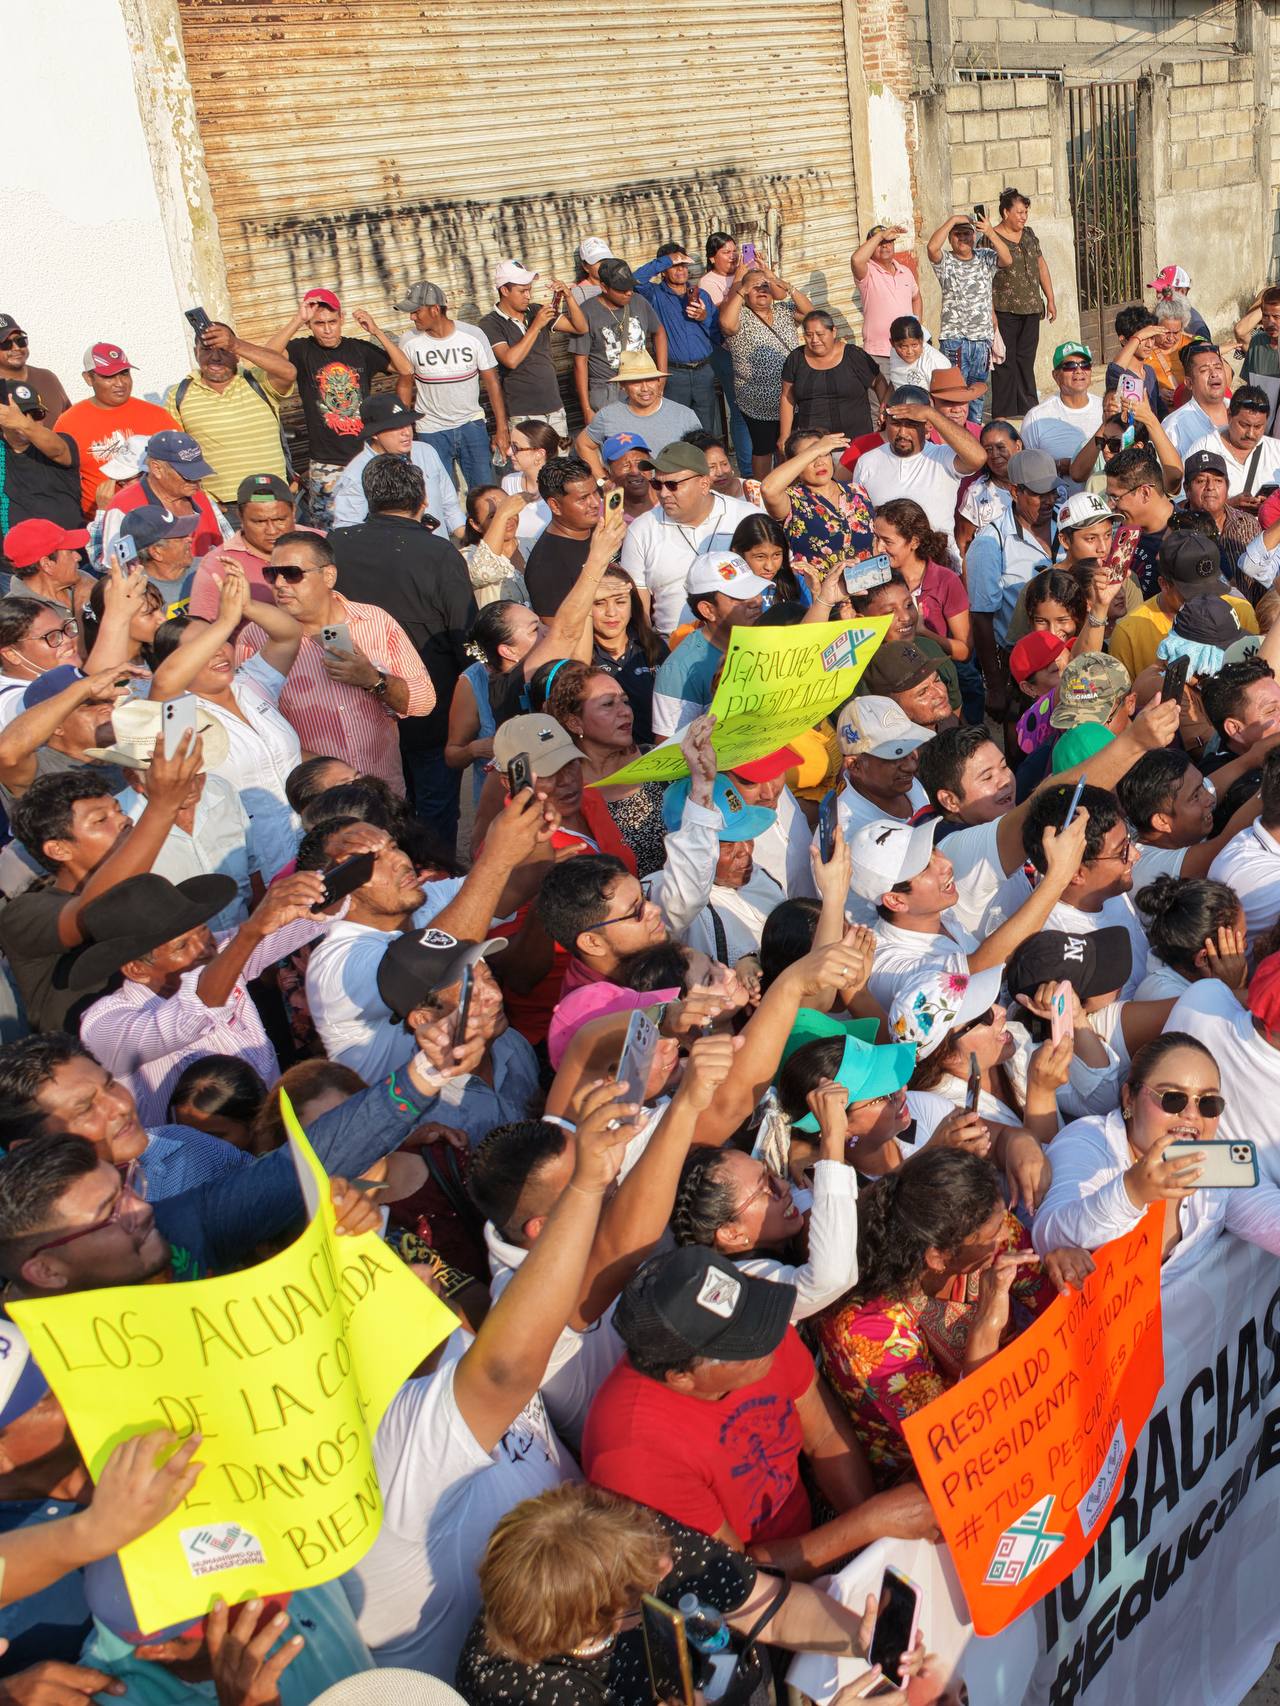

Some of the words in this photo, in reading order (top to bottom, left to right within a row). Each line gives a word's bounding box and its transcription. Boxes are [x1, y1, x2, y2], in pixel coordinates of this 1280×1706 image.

[1087, 495, 1105, 511] LA
[43, 1311, 164, 1372] LOS
[926, 1346, 1051, 1464] RESPALDO
[1053, 1293, 1096, 1351] TOTAL
[1102, 1266, 1116, 1290] A
[1125, 1234, 1149, 1269] LA
[1132, 1308, 1156, 1350] DE
[154, 1395, 218, 1440] DE
[241, 1383, 315, 1434] LA
[941, 1370, 1081, 1508] PRESIDENTA
[1083, 1273, 1145, 1366] CLAUDIA
[219, 1421, 361, 1503] DAMOS
